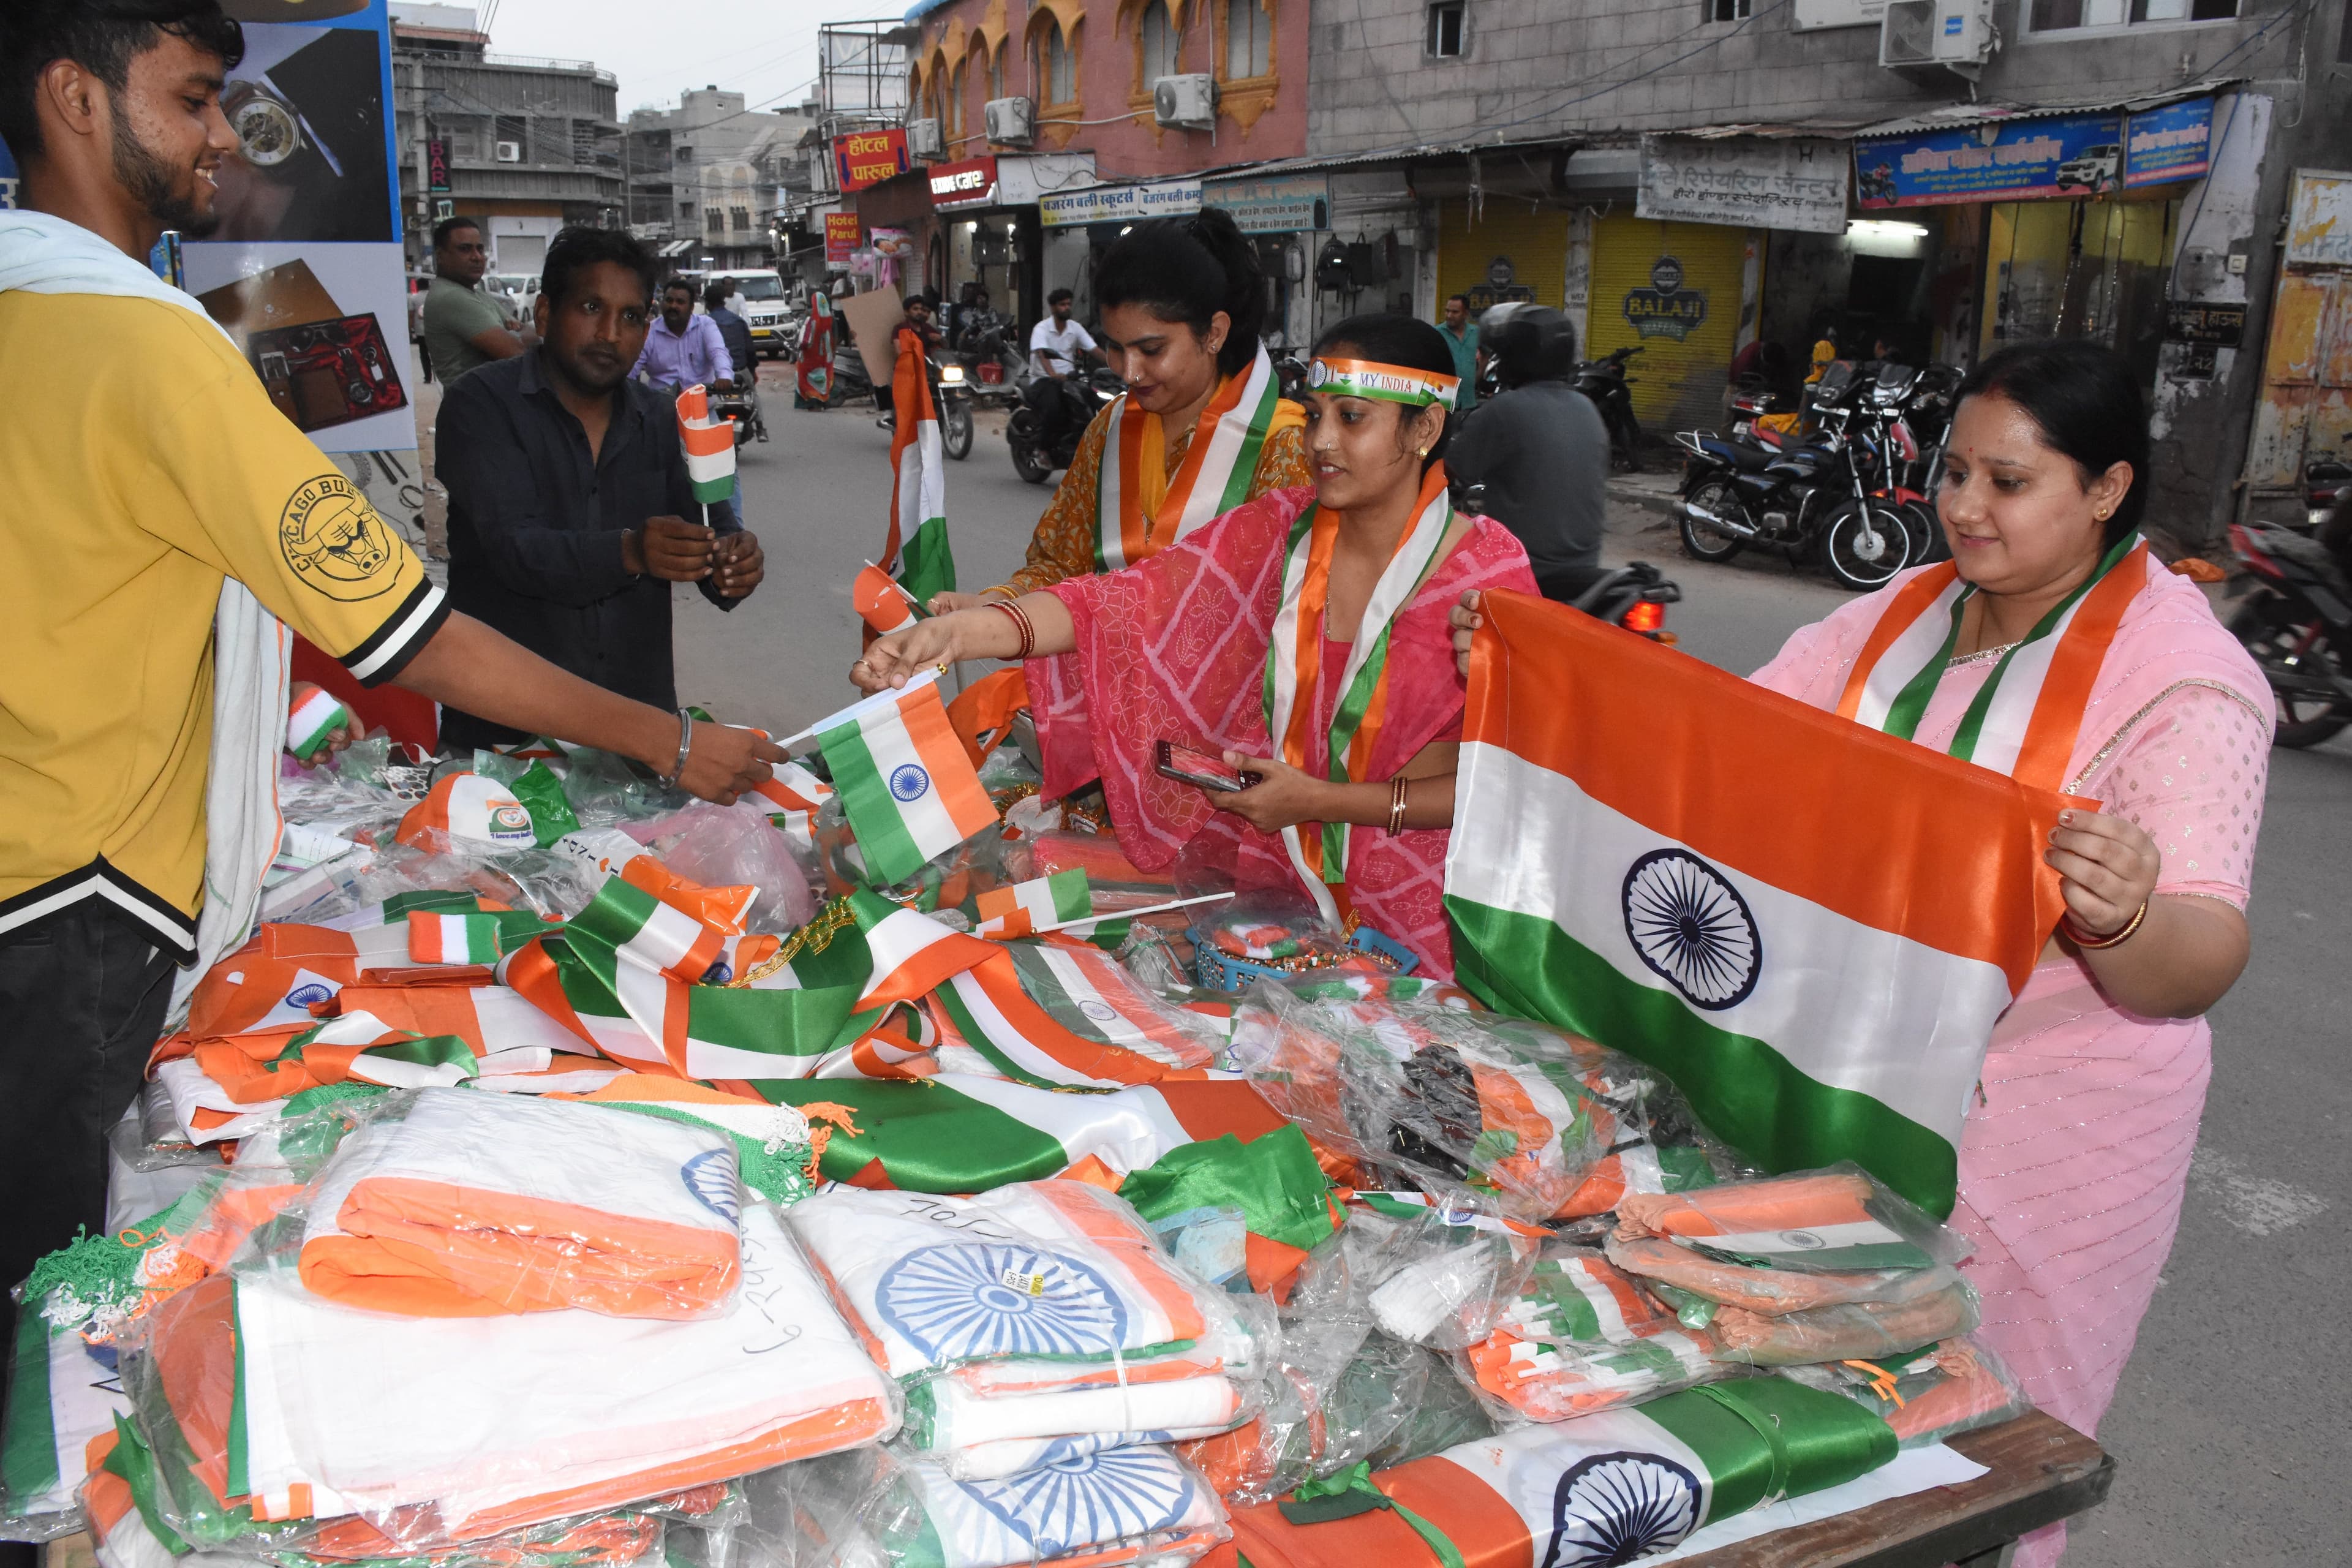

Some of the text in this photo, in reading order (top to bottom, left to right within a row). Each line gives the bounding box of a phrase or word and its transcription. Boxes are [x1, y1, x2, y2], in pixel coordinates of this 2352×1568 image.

[848, 135, 889, 156] होटल
[431, 140, 447, 184] BAR
[930, 175, 956, 195] EXIDE
[1043, 187, 1134, 211] बजरंग बली स्कूटर्स
[1143, 190, 1166, 204] बजरंग
[1167, 188, 1183, 203] बली
[827, 216, 858, 226] Hotel
[829, 228, 857, 239] Parul
[1628, 296, 1702, 317] BALAJI
[1330, 365, 1412, 393] I MY INDIA
[285, 488, 316, 572] CCAGO
